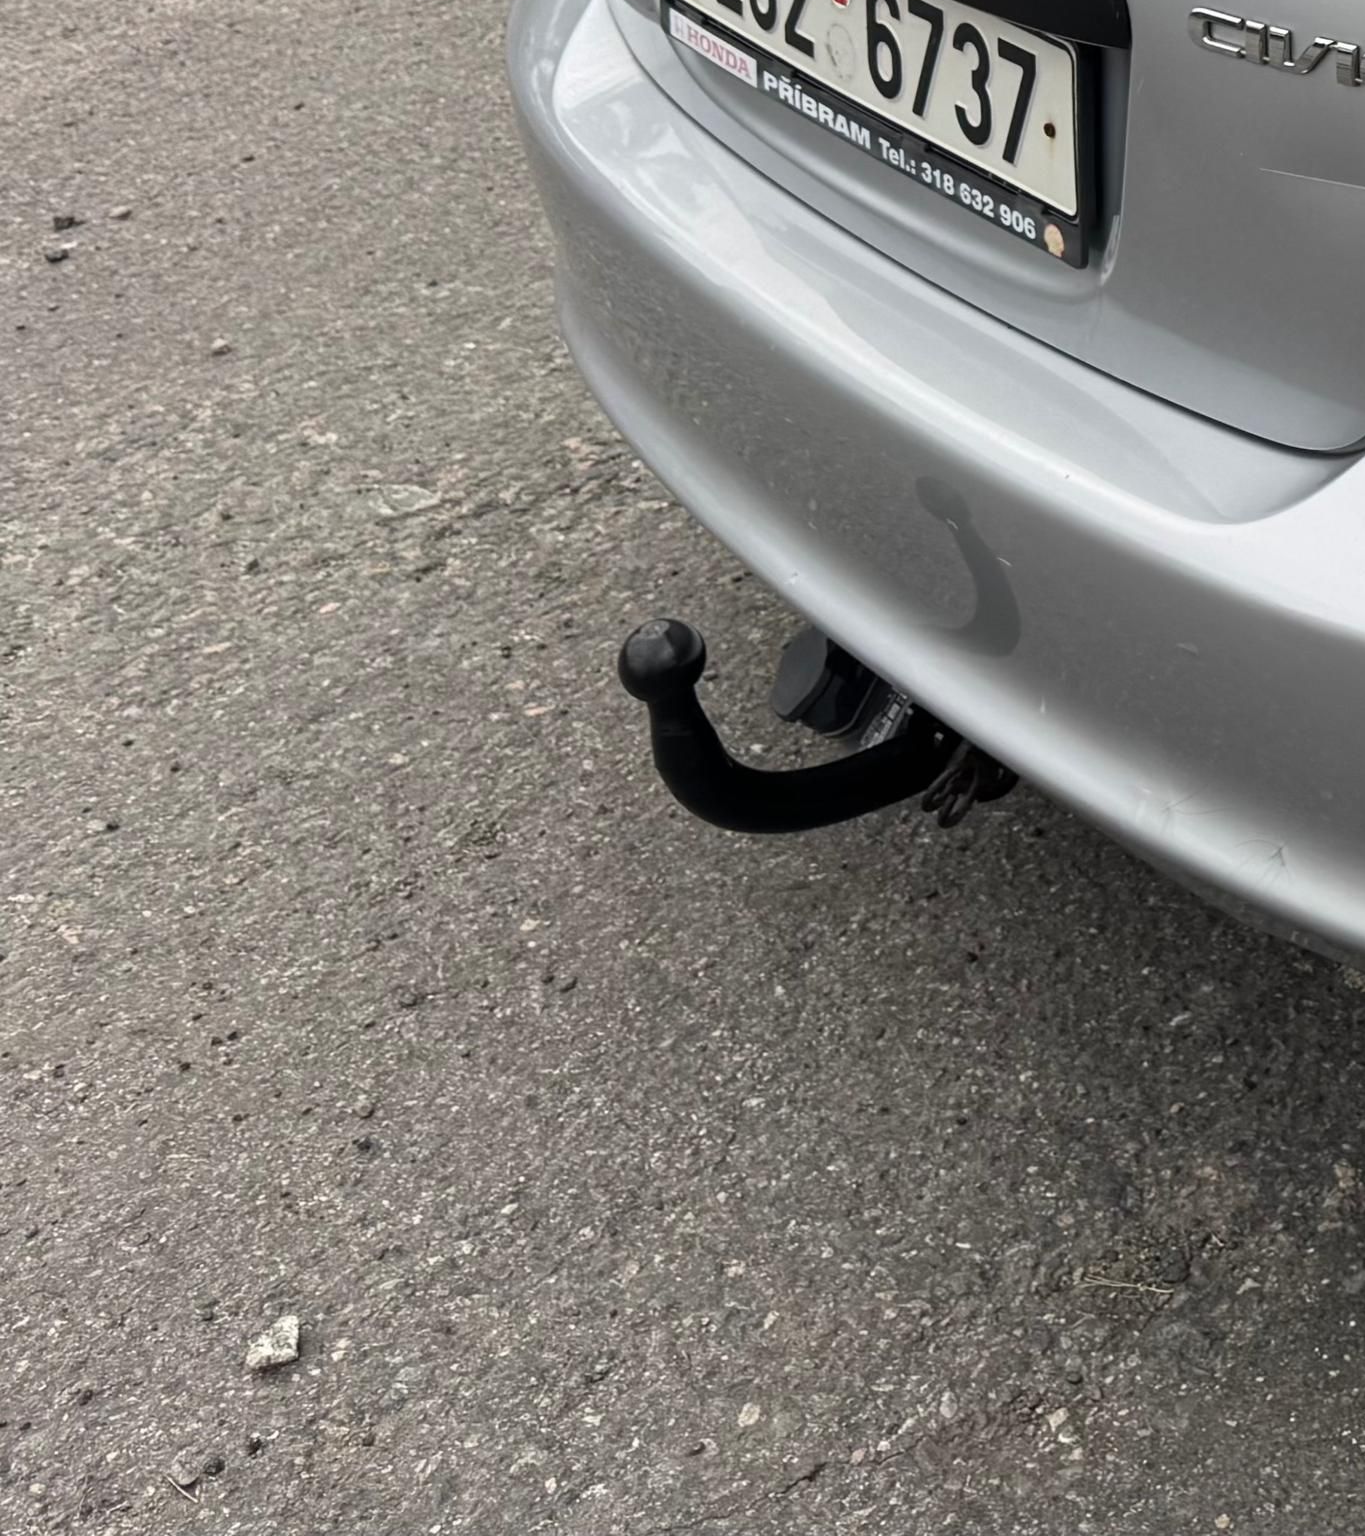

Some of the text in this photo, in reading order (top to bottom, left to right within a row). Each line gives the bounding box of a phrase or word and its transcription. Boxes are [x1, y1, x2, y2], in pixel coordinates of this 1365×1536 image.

[686, 23, 1037, 240] HONDA PŘÍBRAM Tel.: 318 632 906
